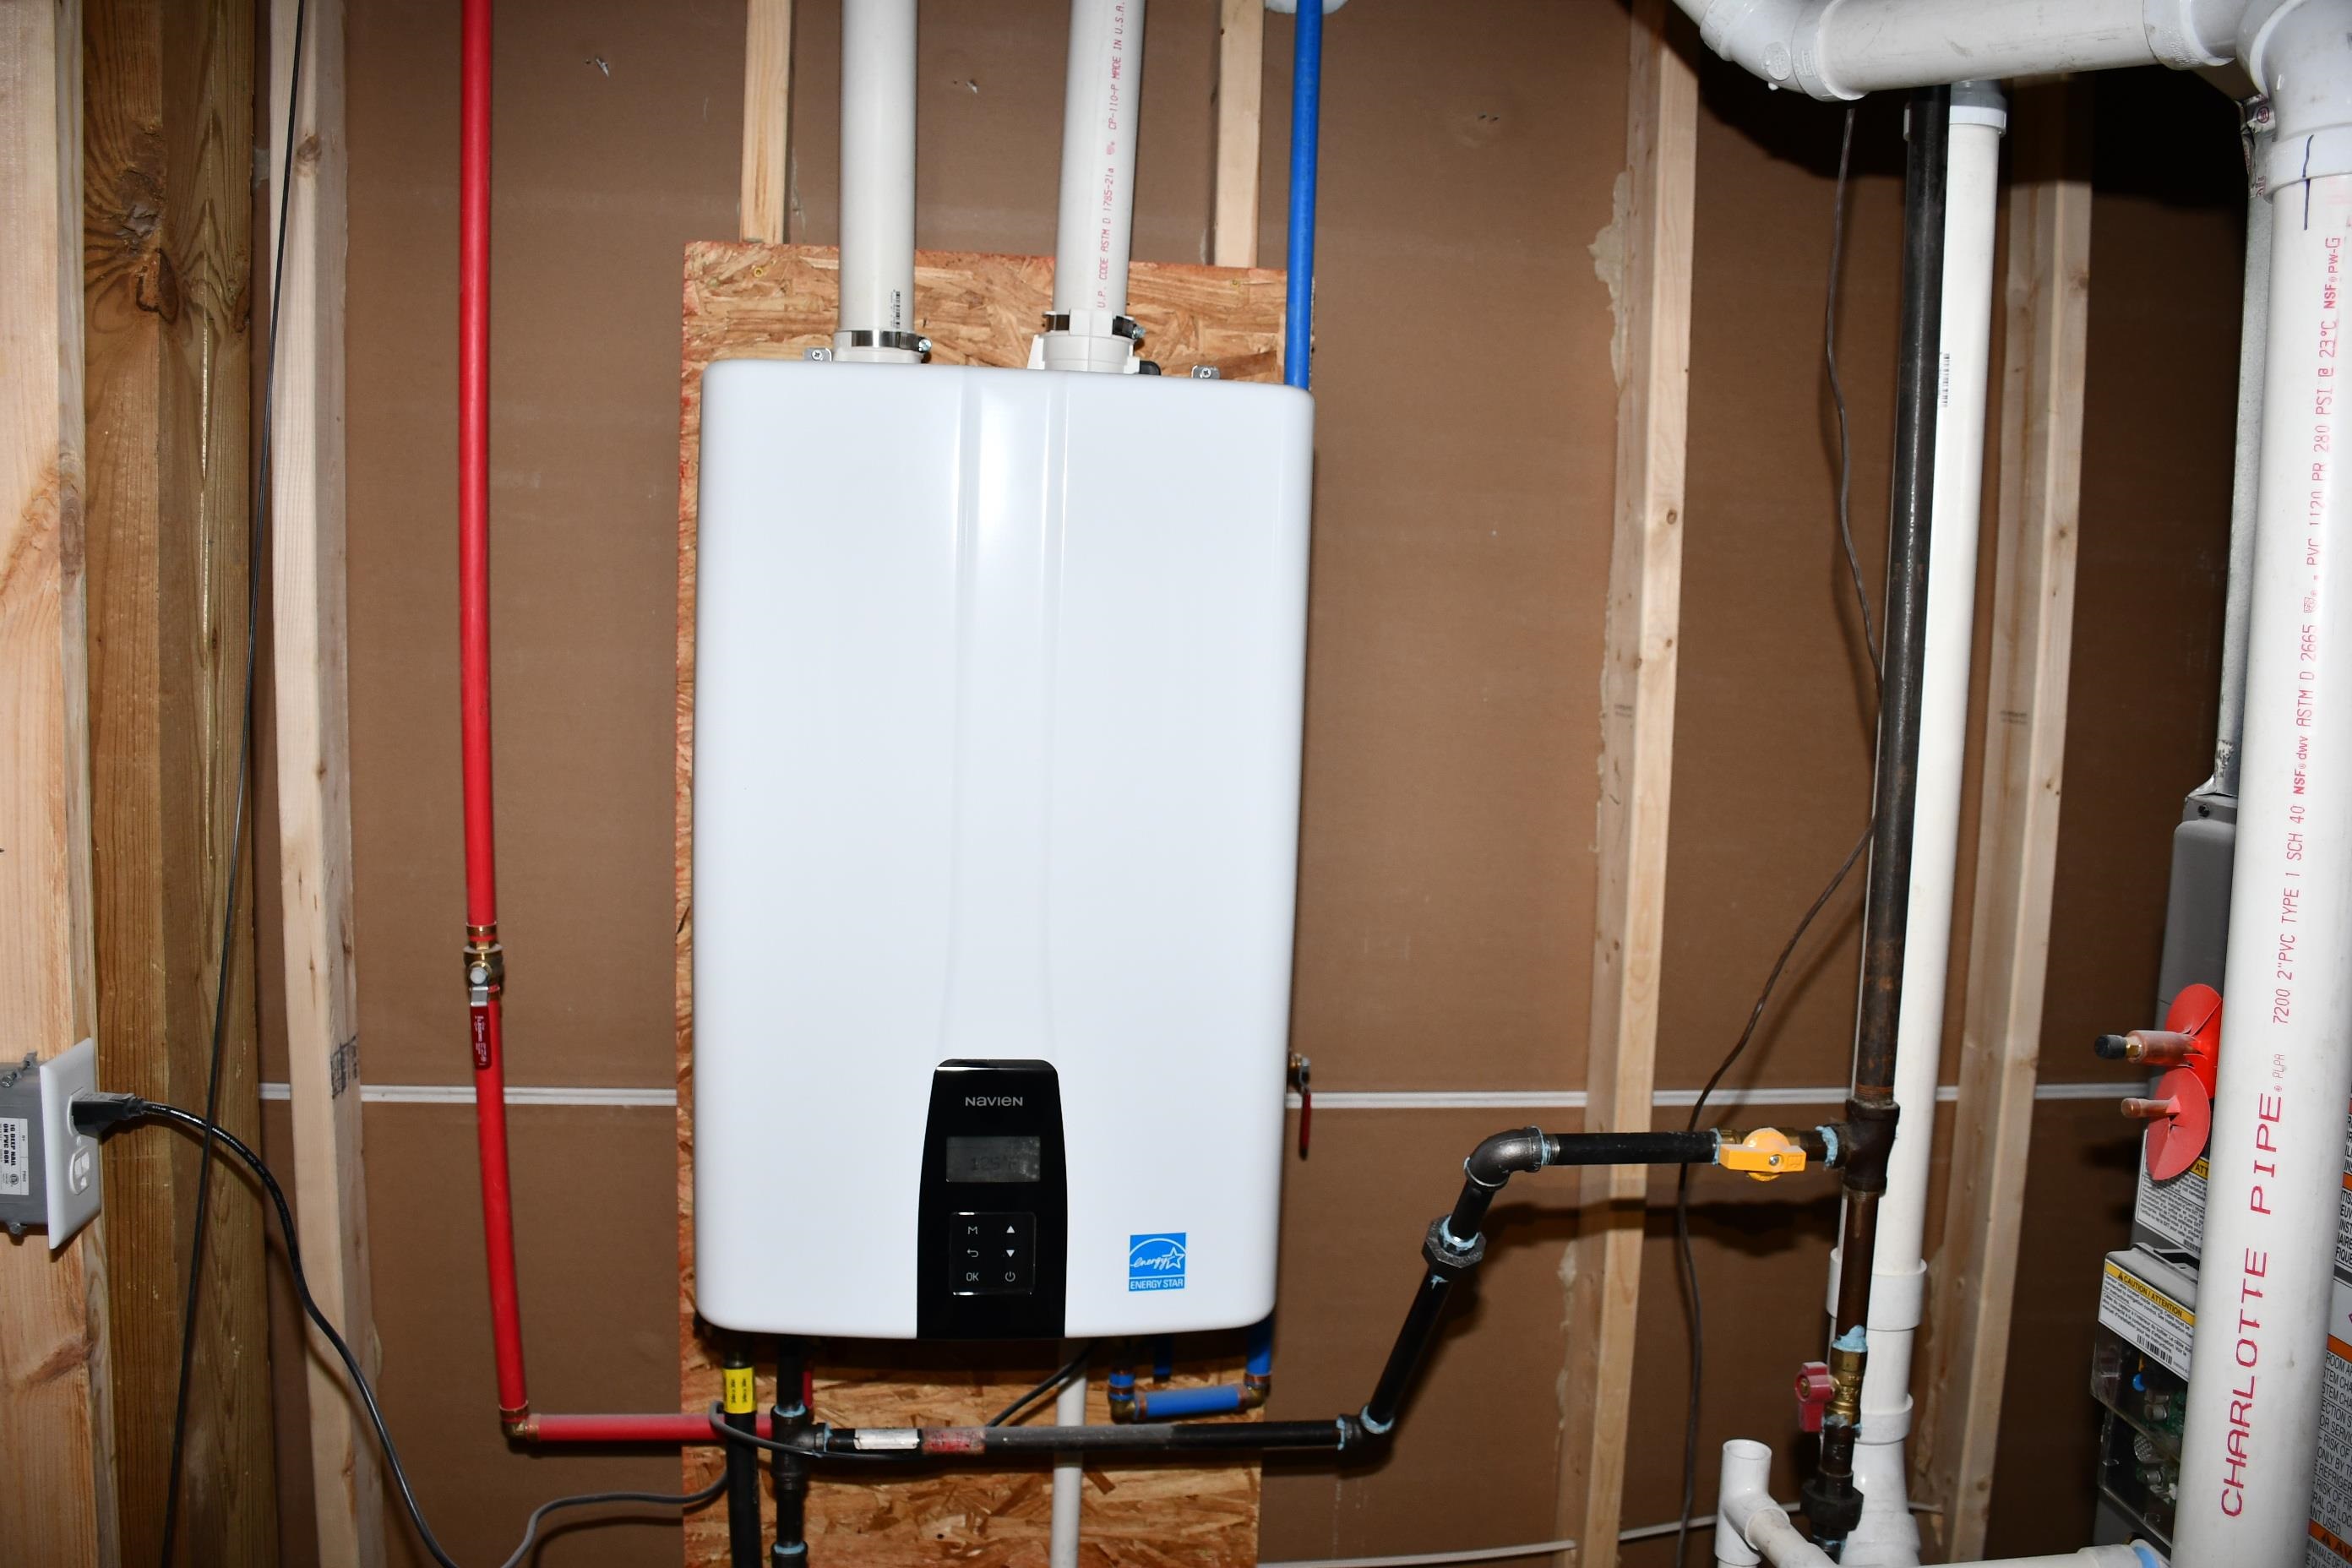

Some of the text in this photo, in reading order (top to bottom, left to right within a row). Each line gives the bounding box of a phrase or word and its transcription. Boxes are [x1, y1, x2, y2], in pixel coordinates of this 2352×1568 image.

[1113, 39, 1123, 51] IN
[1111, 56, 1122, 80] MADE
[1100, 228, 1111, 253] ASTM
[1098, 258, 1108, 280] CODE
[2315, 388, 2333, 416] PSI
[2313, 424, 2330, 453] 280
[2311, 462, 2326, 482] PR
[2300, 623, 2317, 662] 2665
[2299, 670, 2316, 682] D
[2295, 689, 2314, 727] ASTM
[2289, 804, 2306, 825] 40
[2286, 832, 2304, 861] SCH
[2281, 887, 2300, 924] TYPE
[2273, 988, 2291, 1026] 7200
[967, 1226, 978, 1234] M
[966, 1271, 979, 1282] OK
[1130, 1278, 1184, 1290] ENERGY STAR
[2123, 1276, 2148, 1296] CAUTION
[2151, 1292, 2183, 1318] ATTENTION
[2220, 1247, 2269, 1517] CHARLOTTE
